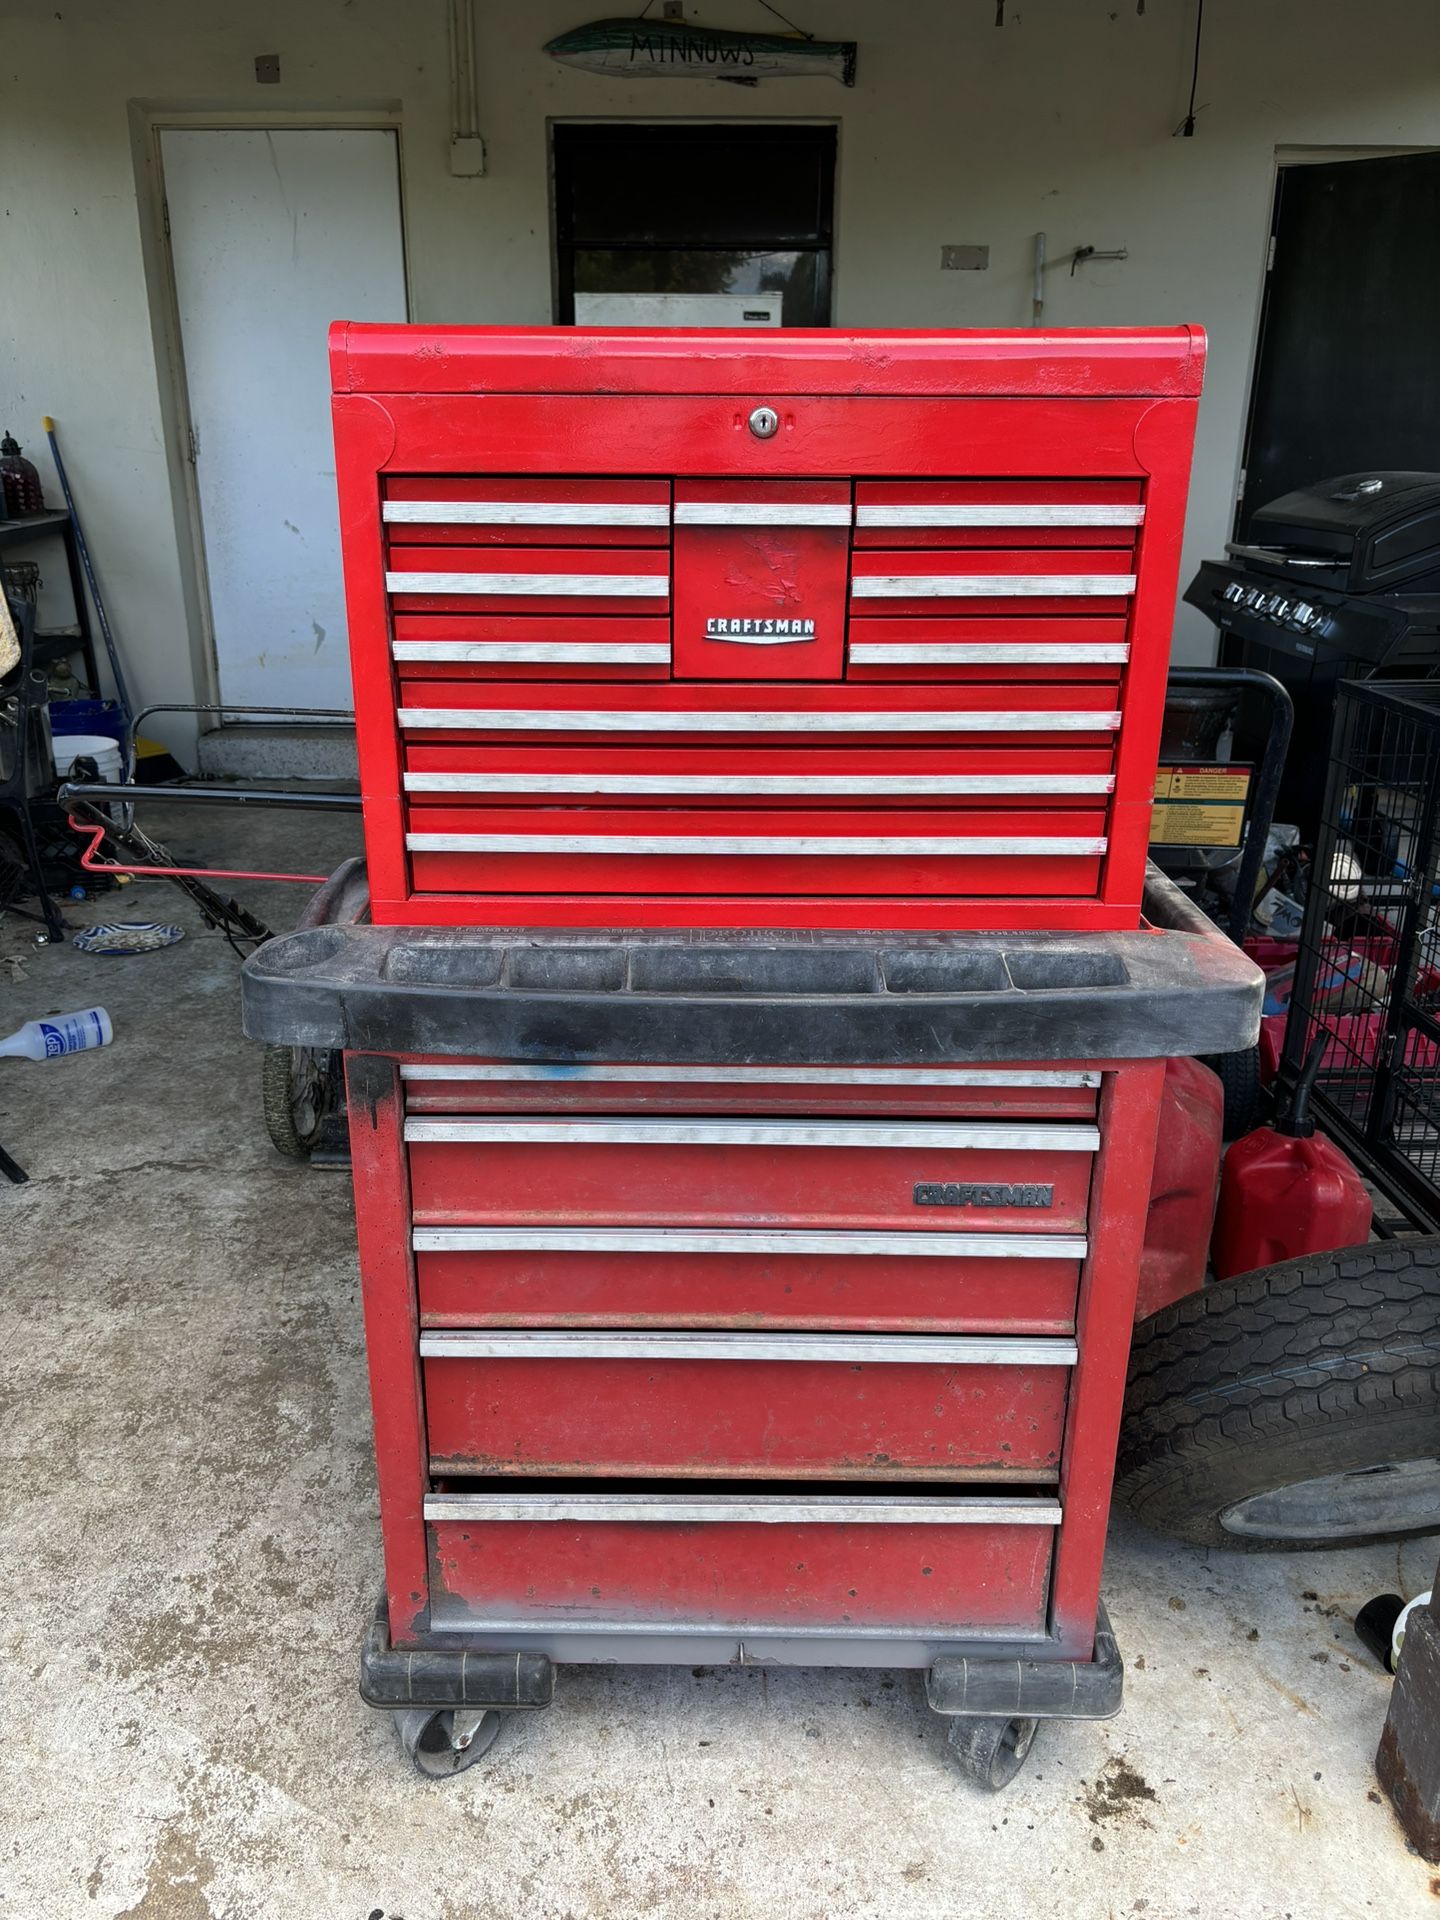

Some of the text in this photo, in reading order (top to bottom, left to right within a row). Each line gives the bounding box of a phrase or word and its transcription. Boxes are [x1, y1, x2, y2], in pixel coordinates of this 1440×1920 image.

[631, 33, 755, 65] MINNOWS
[707, 618, 815, 633] CRAFTSMAN
[695, 930, 806, 941] PROJECT
[913, 1182, 1055, 1207] CRAFTSMAN
